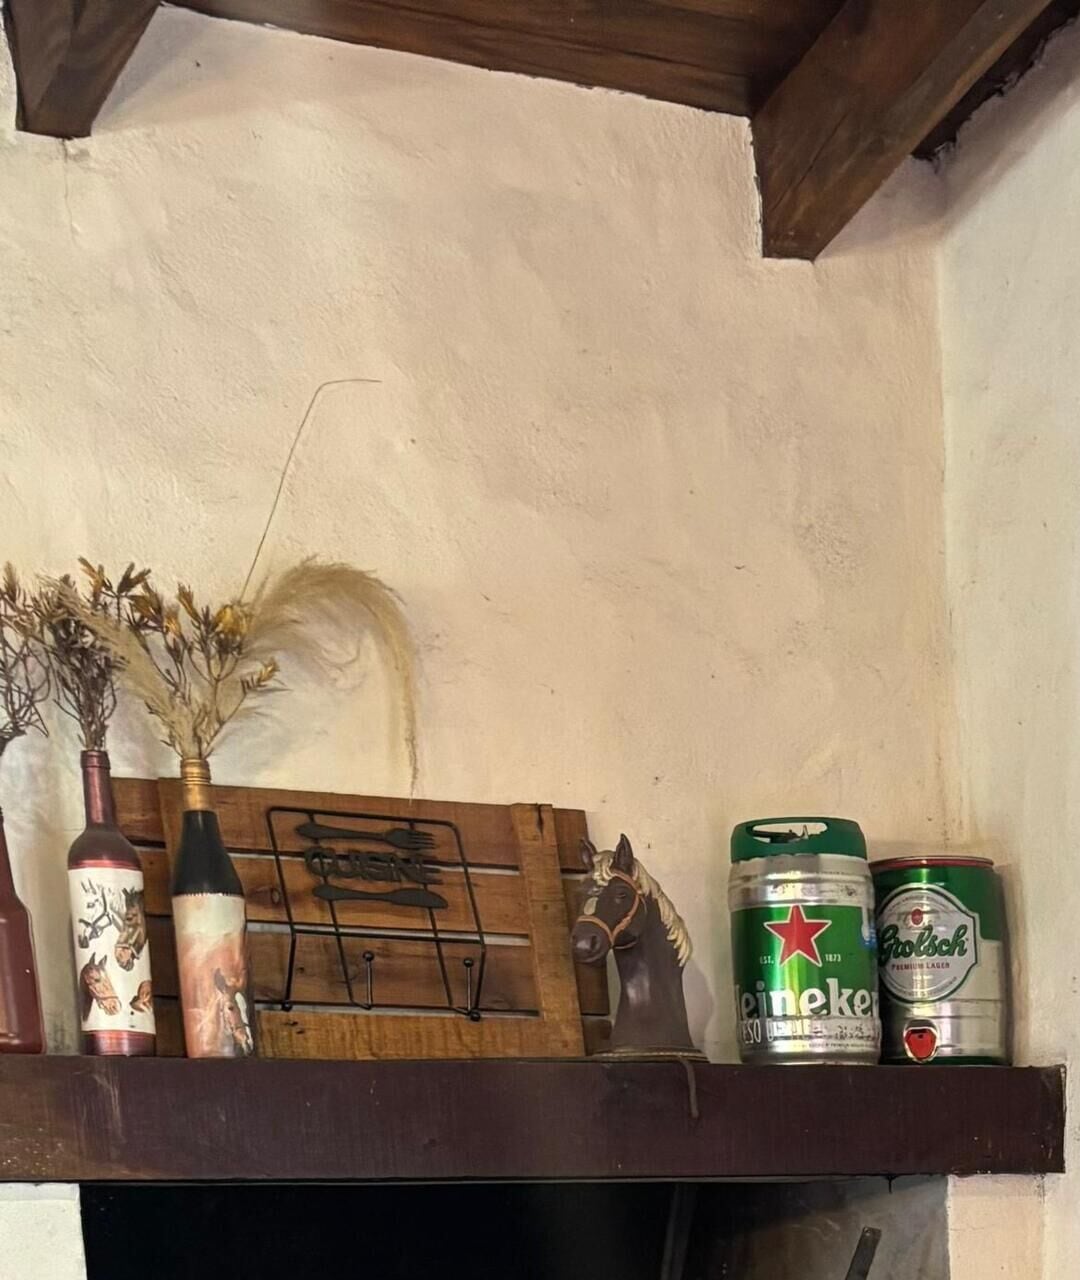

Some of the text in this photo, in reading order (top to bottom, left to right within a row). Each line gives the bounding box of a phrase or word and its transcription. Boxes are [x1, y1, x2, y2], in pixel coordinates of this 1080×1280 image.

[880, 924, 968, 968] Grolsch
[825, 953, 842, 962] 1873
[891, 963, 924, 971] PREMIUM
